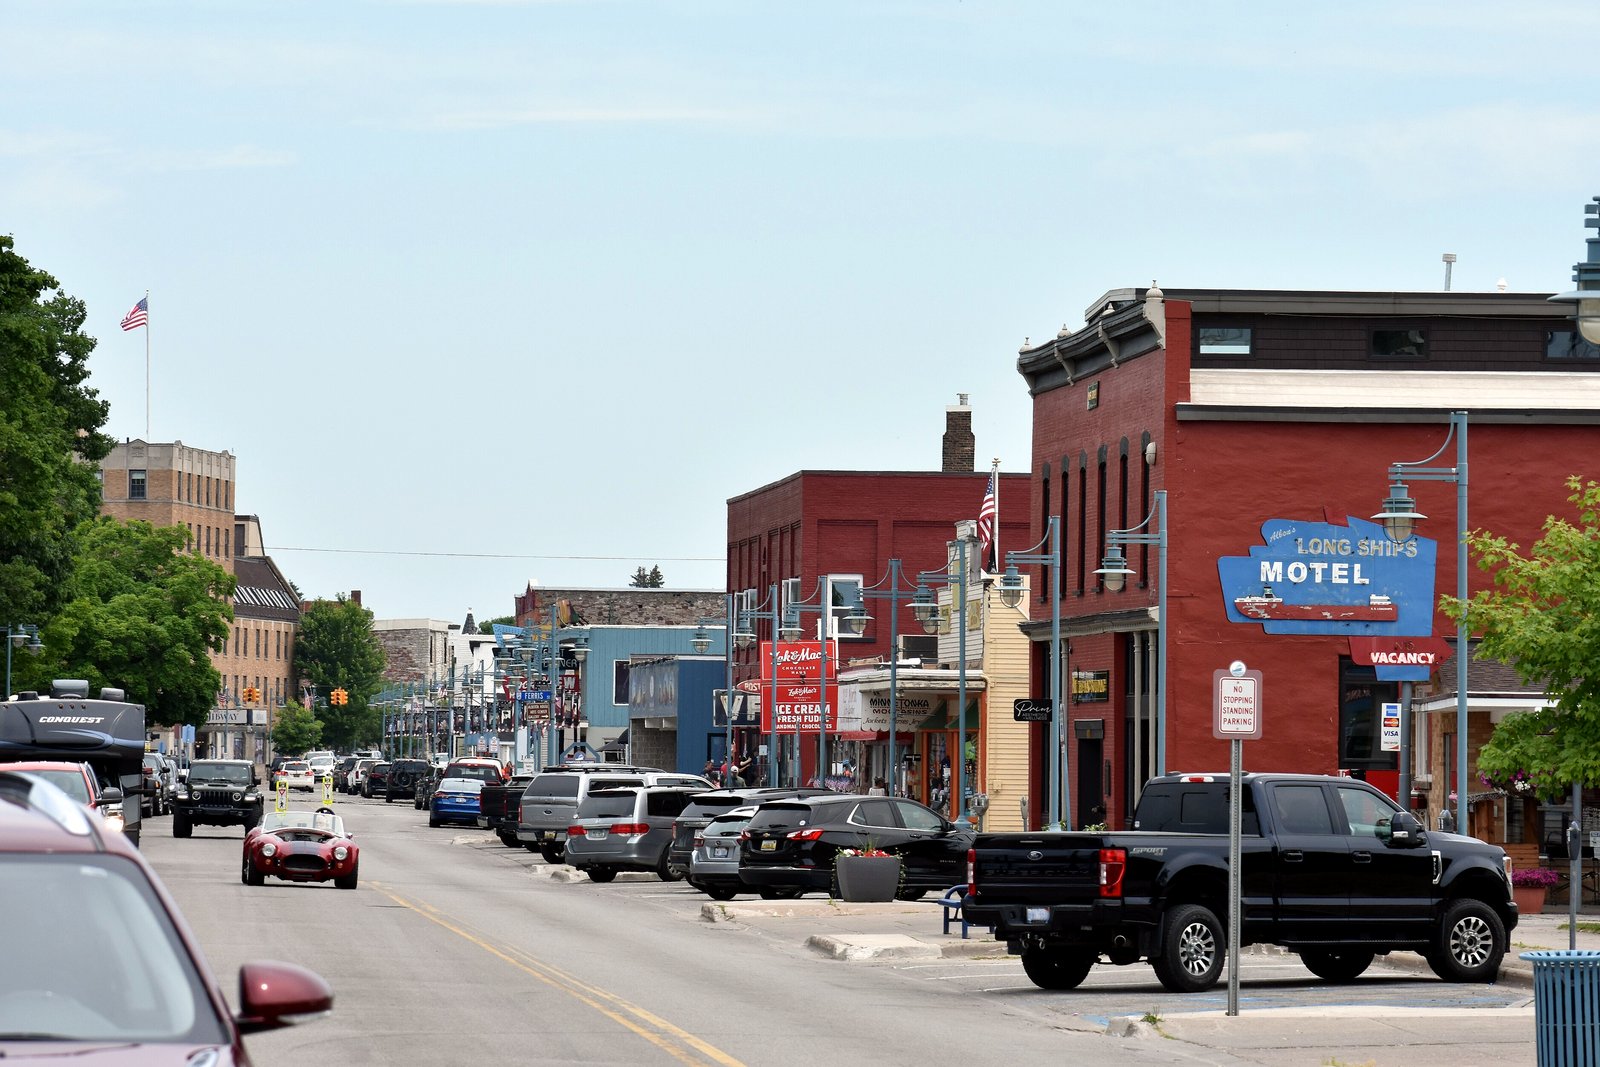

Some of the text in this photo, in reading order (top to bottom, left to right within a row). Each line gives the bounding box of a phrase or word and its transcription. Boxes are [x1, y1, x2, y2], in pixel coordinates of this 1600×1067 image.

[1297, 538, 1418, 558] LONG SHIPS
[1260, 561, 1370, 584] MOTEL
[1370, 652, 1435, 664] VACANCY
[524, 692, 544, 700] FERRIS
[1223, 696, 1253, 704] STOPPING
[776, 705, 791, 714] ICE
[1222, 706, 1253, 715] STANDING
[1223, 718, 1252, 726] PARKING
